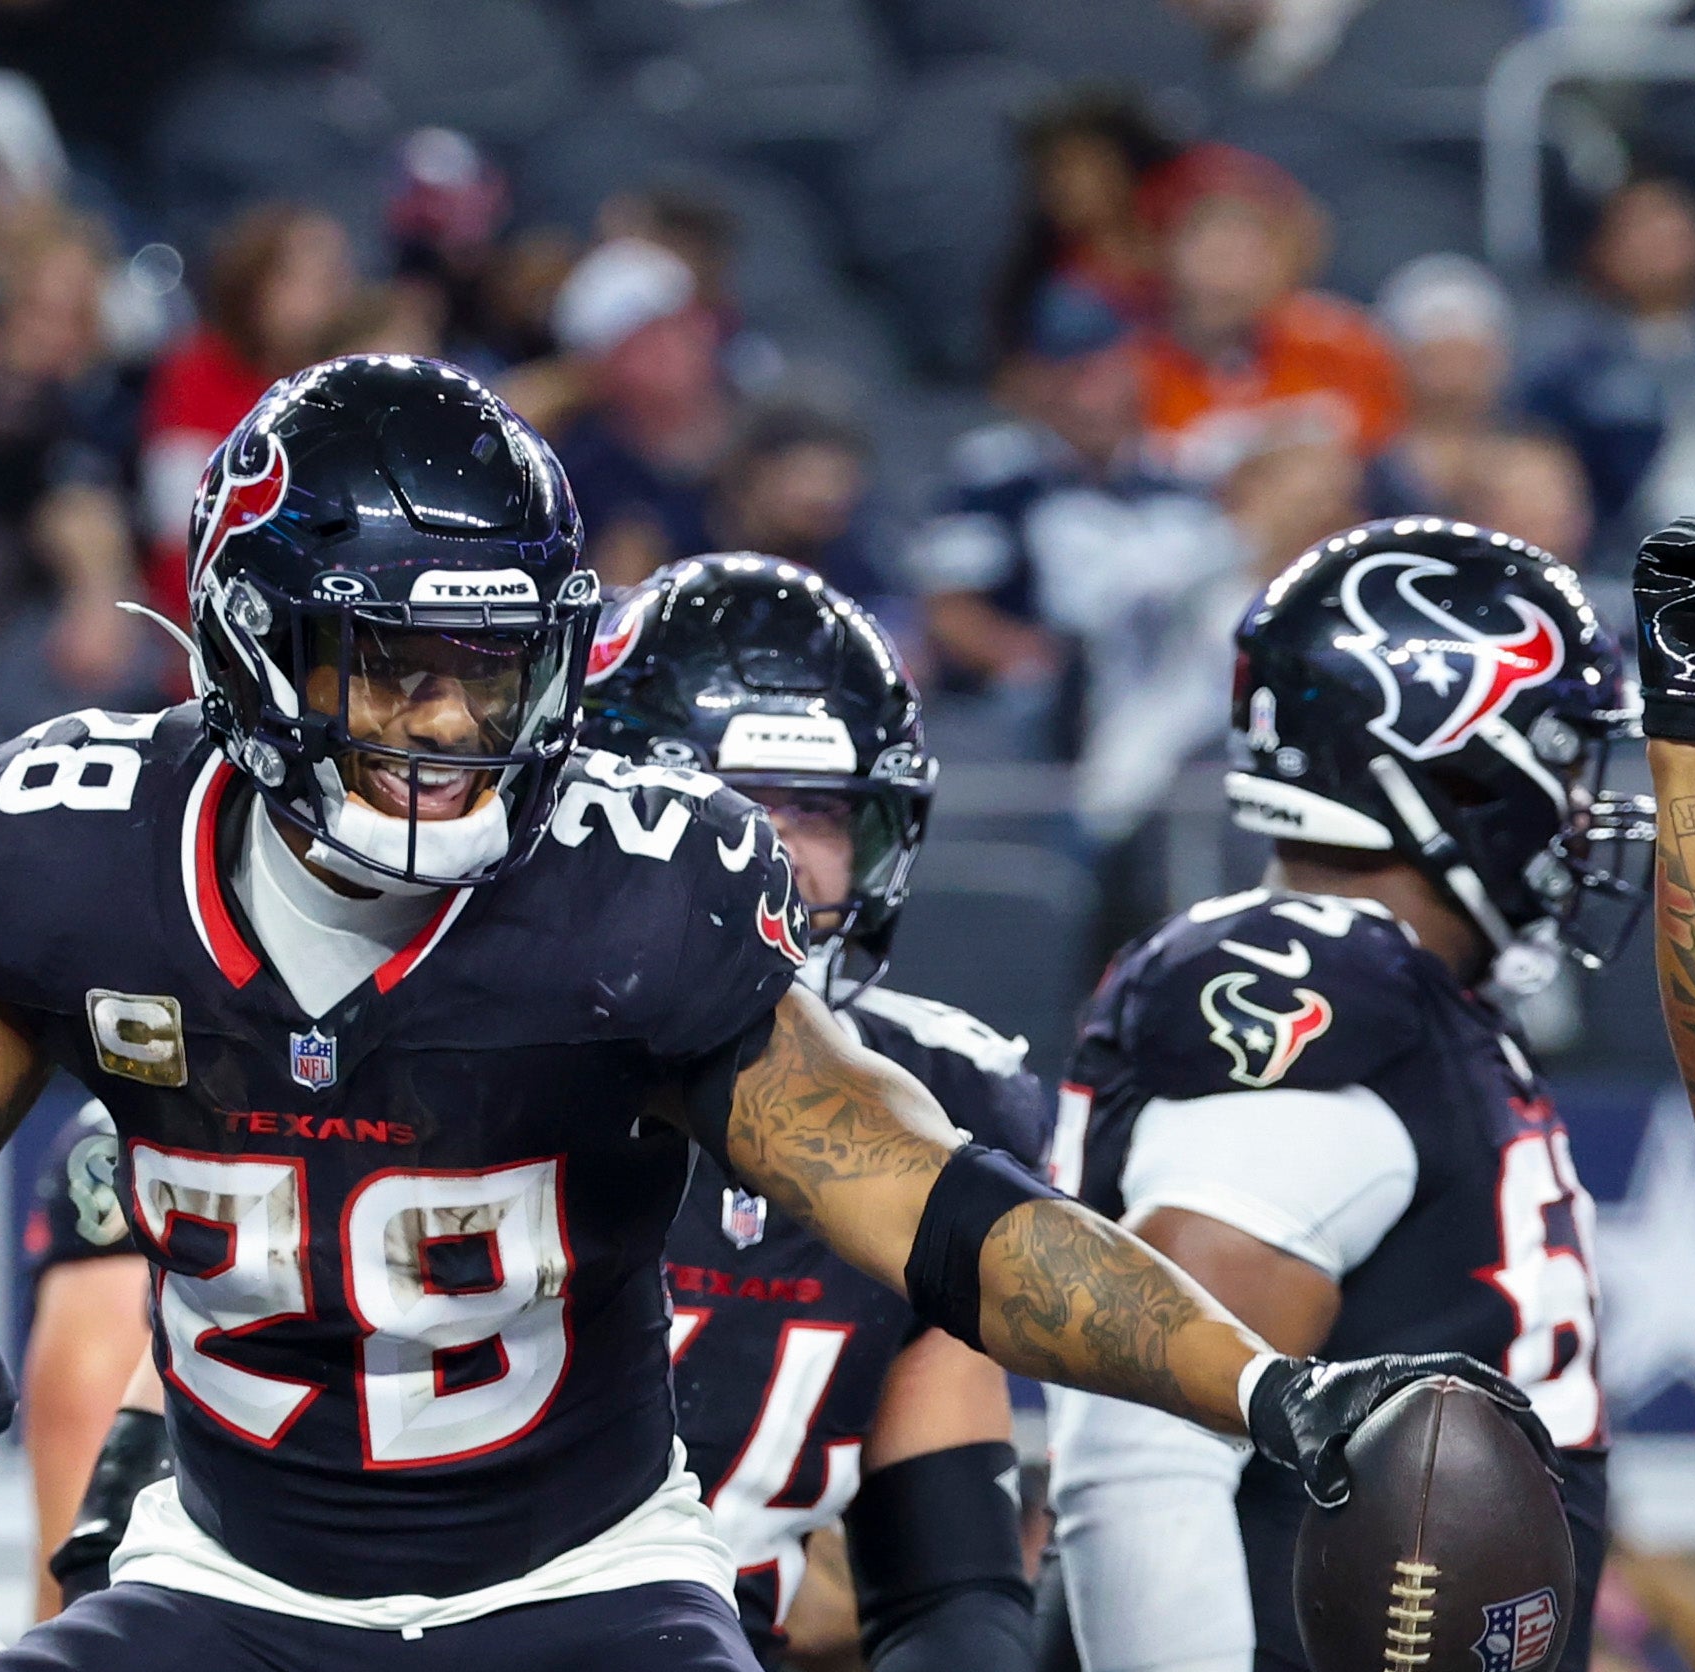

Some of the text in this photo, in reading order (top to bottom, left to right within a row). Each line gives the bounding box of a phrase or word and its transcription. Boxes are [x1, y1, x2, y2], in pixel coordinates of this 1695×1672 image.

[430, 582, 529, 598] TEXANS
[746, 731, 837, 745] TEXANS
[94, 998, 174, 1063] C
[299, 1057, 330, 1080] NFL
[220, 1110, 415, 1144] TEXANS
[667, 1261, 824, 1304] EXANS
[127, 1137, 575, 1470] 28
[1515, 1598, 1553, 1667] NFL
